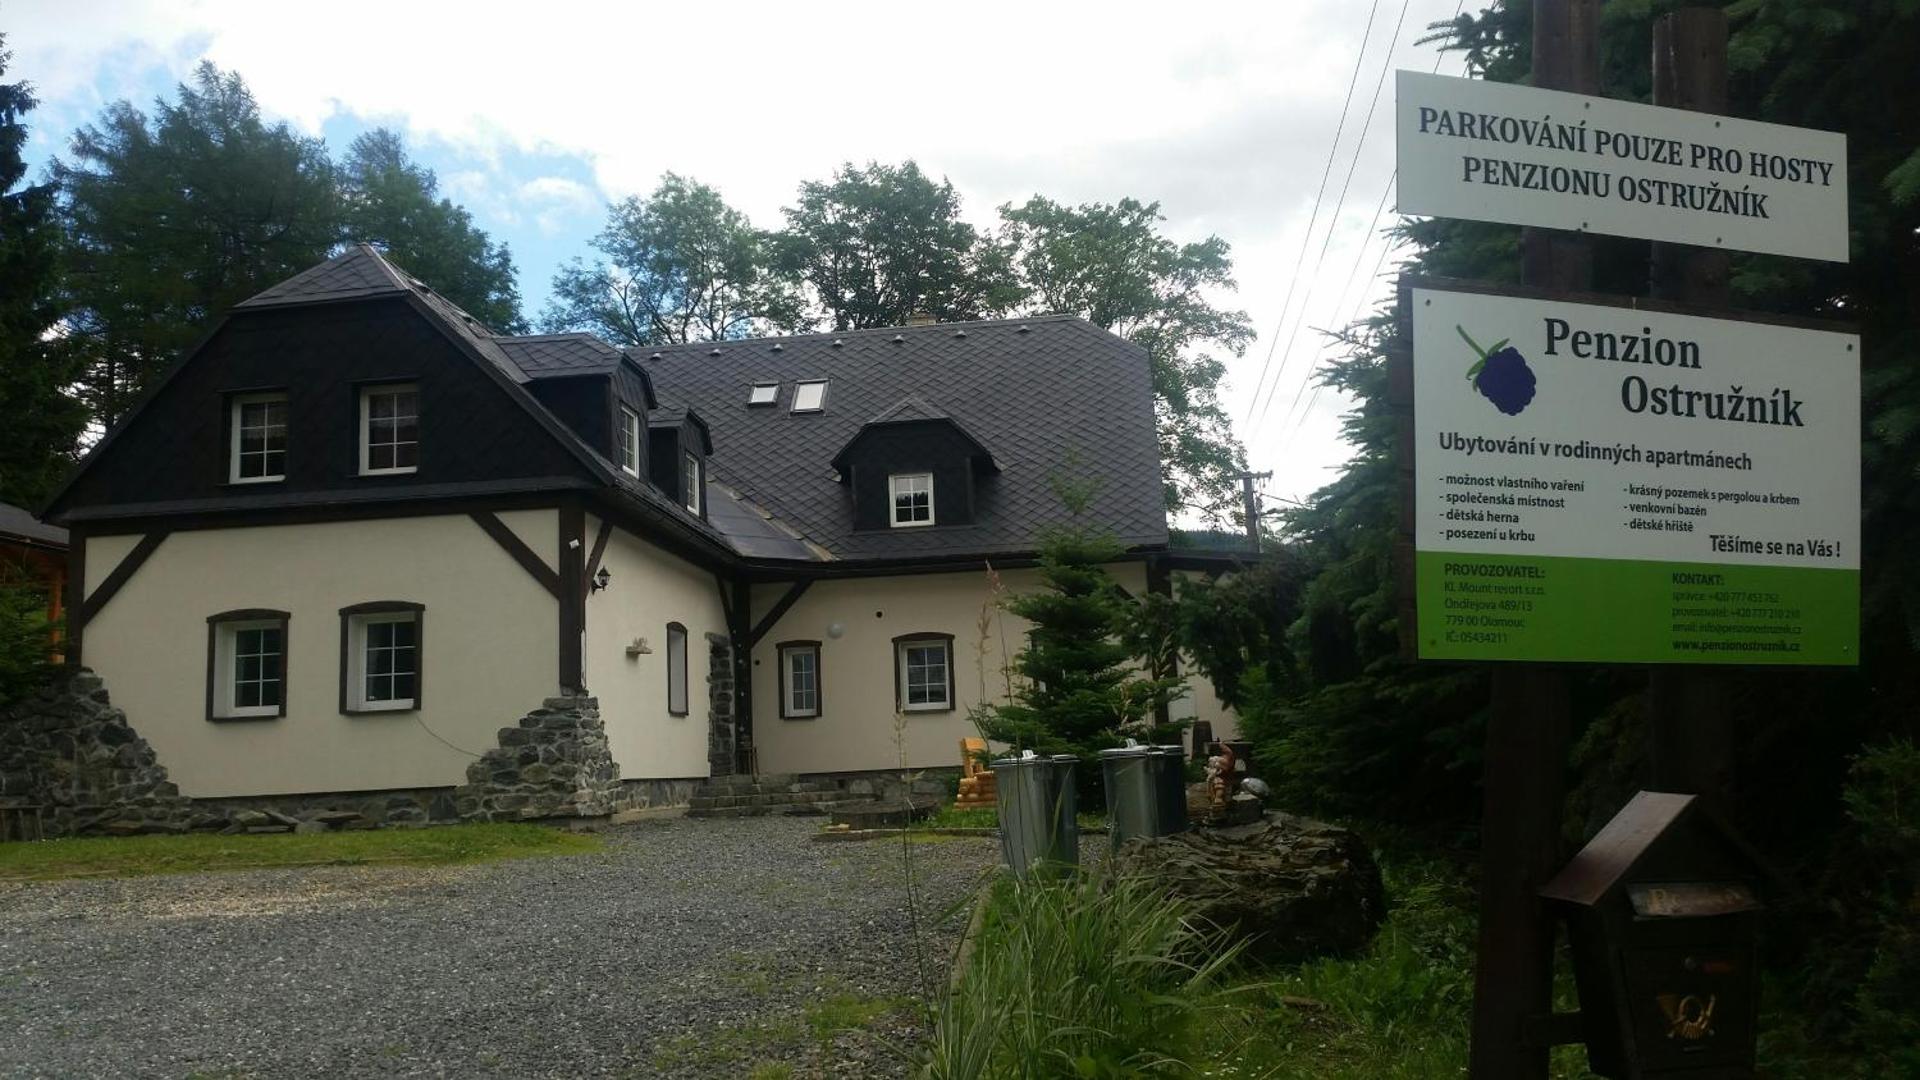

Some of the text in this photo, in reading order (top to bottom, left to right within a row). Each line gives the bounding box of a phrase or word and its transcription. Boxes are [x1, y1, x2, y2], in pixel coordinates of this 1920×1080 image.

[1419, 107, 1834, 187] PARKOVÁNÍ POUZE PRO HOSTY
[1462, 156, 1770, 219] PENZIONU OSTRUŽNÍK
[1544, 317, 1702, 369] Penzion
[1621, 375, 1804, 427] Ostružník
[1439, 432, 1752, 470] Ubytování v rodinných apartmánech
[1446, 474, 1495, 487] možnost
[1497, 476, 1549, 490] vlastního
[1550, 480, 1585, 492] vaření
[1446, 492, 1515, 505] společenská
[1517, 496, 1565, 508] místnost
[1629, 484, 1663, 499] krásný
[1665, 488, 1709, 500] pozemek
[1711, 492, 1716, 500] s
[1718, 492, 1761, 504] pergolou
[1762, 494, 1768, 503] a
[1769, 494, 1800, 505] krbem
[1446, 510, 1484, 522] dětská
[1487, 511, 1520, 523] herna
[1629, 502, 1676, 514] venkovní
[1678, 504, 1707, 516] bazén
[1629, 518, 1663, 531] dětské
[1665, 519, 1694, 532] hřiště
[1446, 528, 1497, 541] posezení
[1499, 531, 1506, 540] u
[1509, 529, 1535, 541] krbu
[1709, 534, 1763, 554] Těšíme
[1766, 542, 1783, 555] se
[1786, 543, 1804, 556] na
[1444, 563, 1546, 578] PROVOZOVATEL:
[1672, 573, 1724, 586] KONTAKT:
